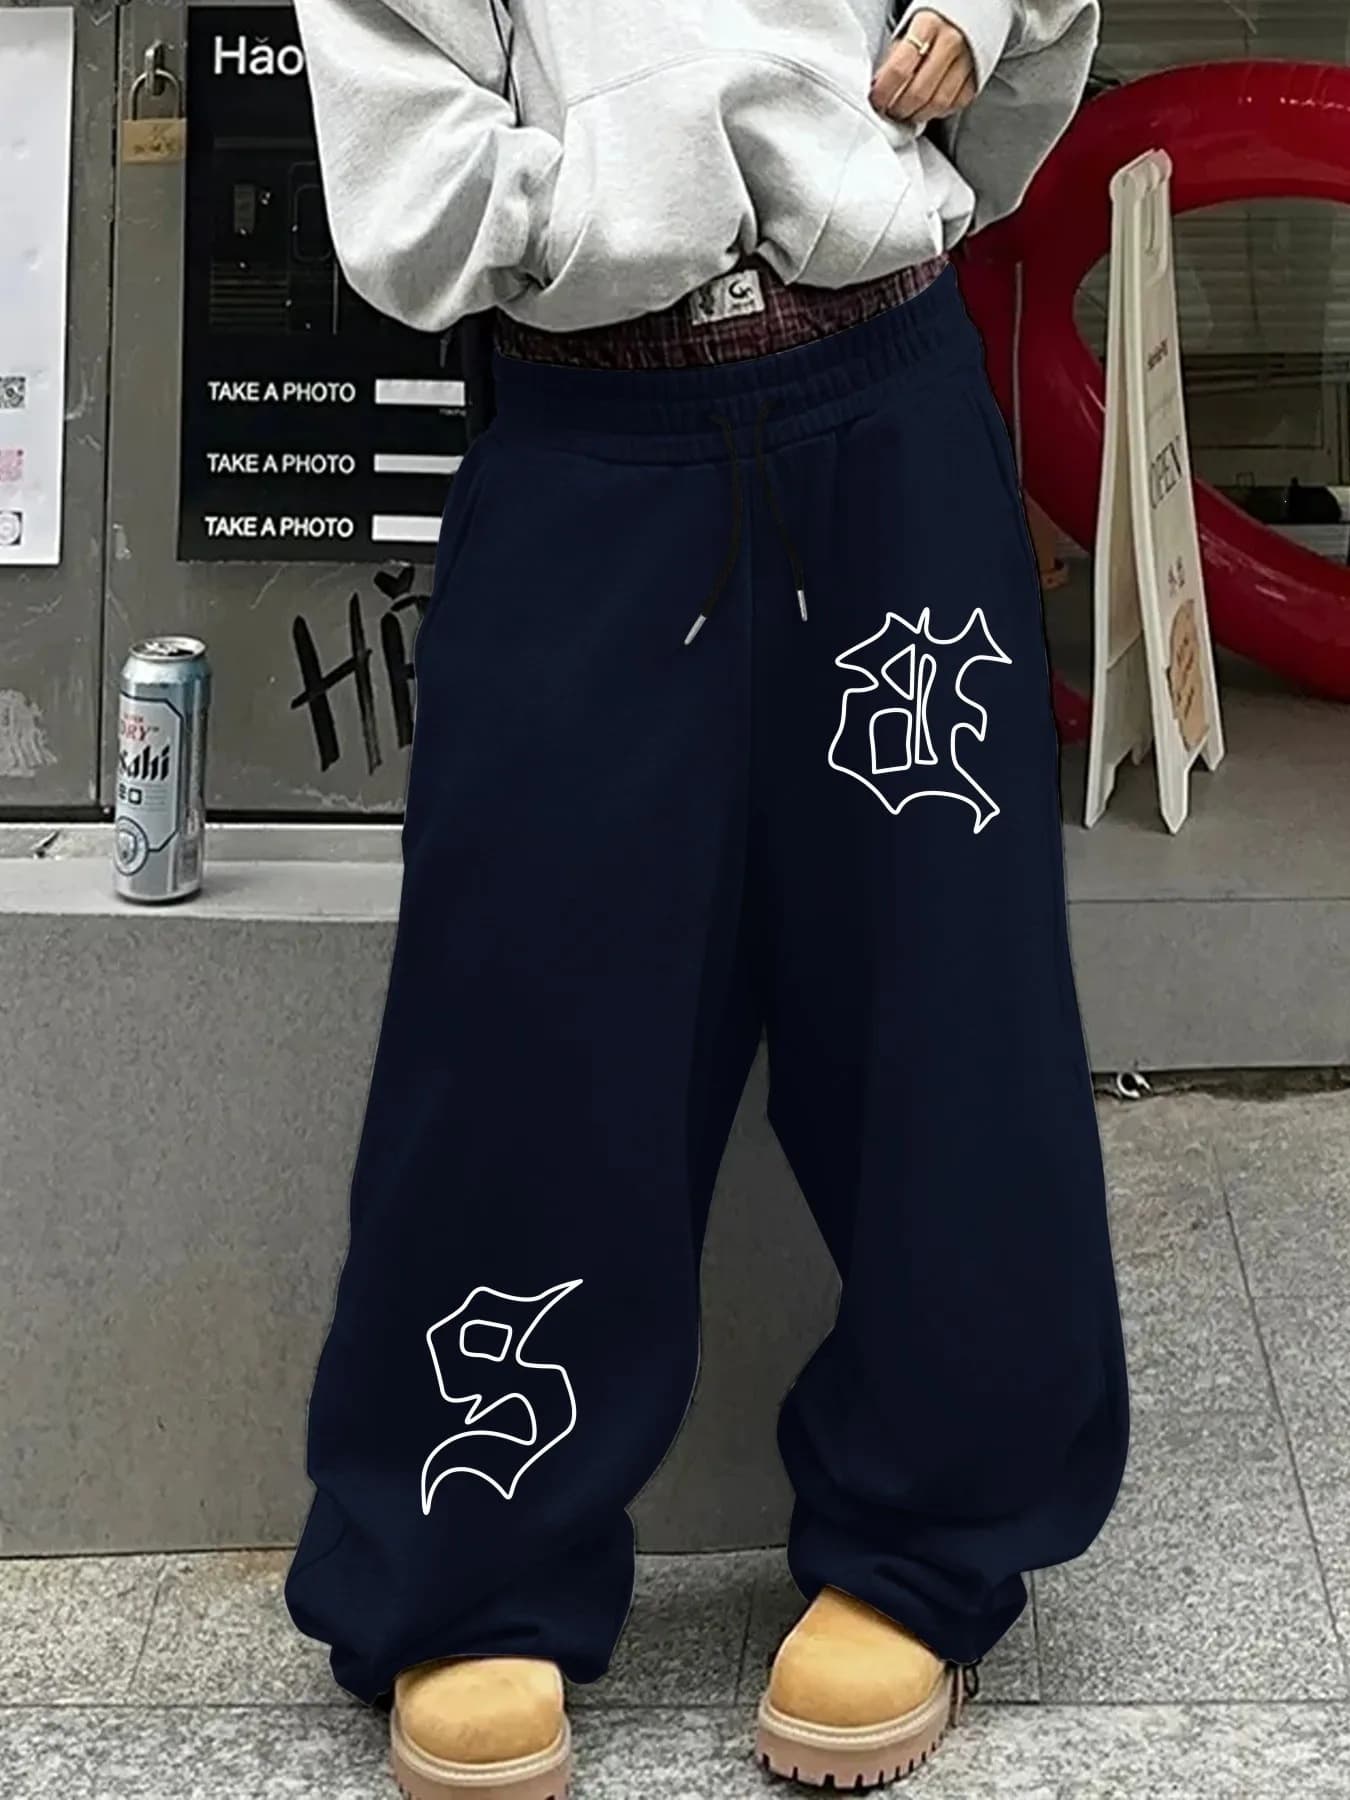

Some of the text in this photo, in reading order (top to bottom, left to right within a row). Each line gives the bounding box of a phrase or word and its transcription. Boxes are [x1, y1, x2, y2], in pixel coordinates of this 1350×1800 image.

[208, 381, 356, 403] TAKE A PHOTO
[206, 453, 356, 475] TAKE A PHOTO
[204, 516, 355, 539] TAKE A PHOTO
[421, 1279, 583, 1515] S
